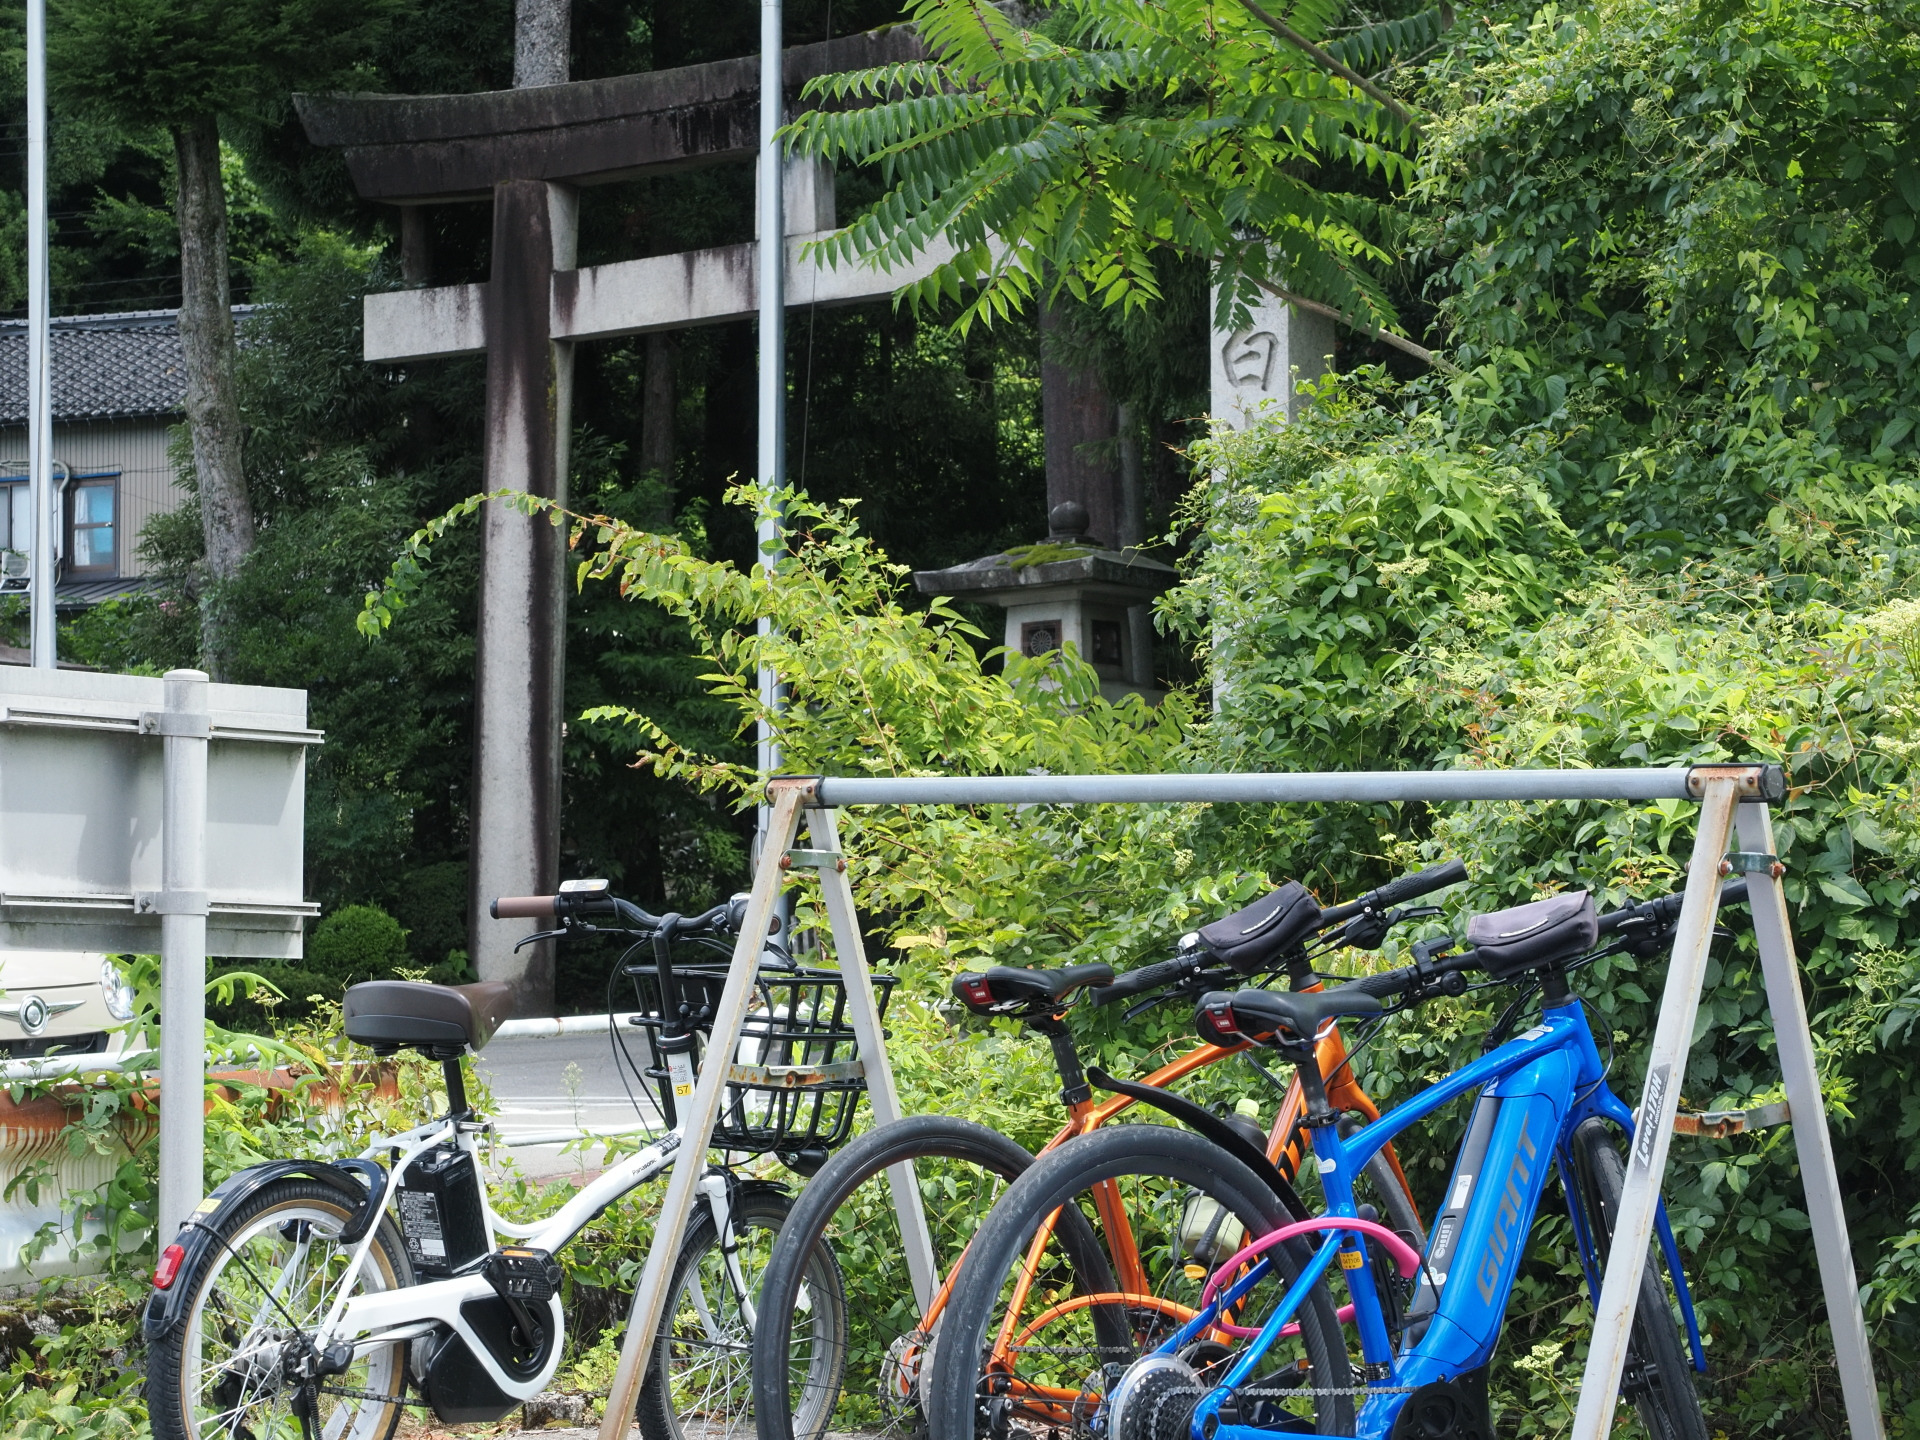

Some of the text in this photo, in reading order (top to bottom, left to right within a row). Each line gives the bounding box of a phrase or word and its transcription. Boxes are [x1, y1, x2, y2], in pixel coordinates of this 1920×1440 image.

[1221, 322, 1280, 432] 白
[677, 1085, 689, 1095] 57
[1637, 1072, 1662, 1167] Level-170H
[631, 1157, 658, 1176] Panasonic
[1476, 1110, 1537, 1307] GIANT
